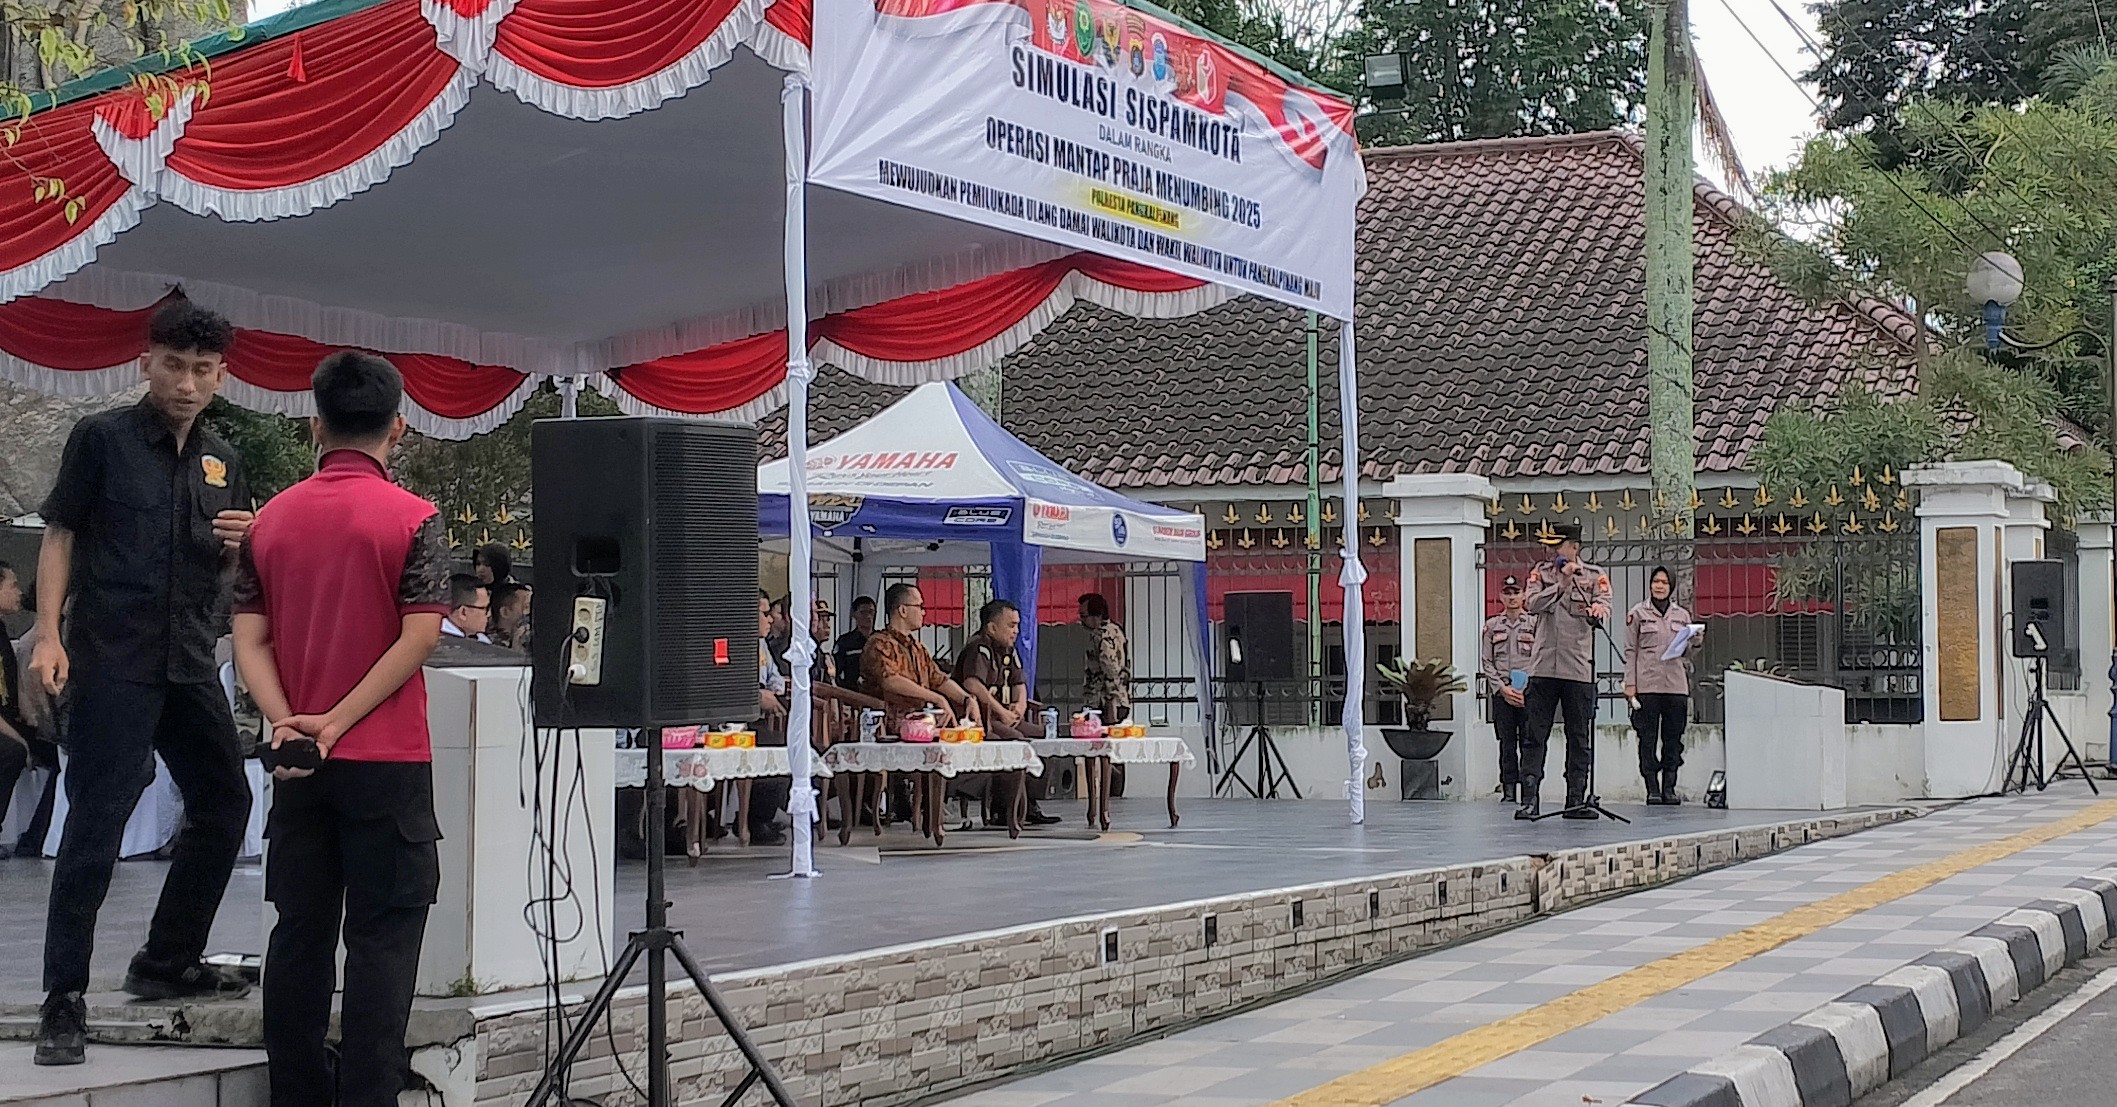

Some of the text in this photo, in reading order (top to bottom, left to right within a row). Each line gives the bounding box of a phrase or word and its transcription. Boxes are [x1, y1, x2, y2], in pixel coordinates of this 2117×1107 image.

[1012, 46, 1242, 163] SIMULASI SISPAMKOTA
[1099, 124, 1173, 164] DALAM RANGKA
[986, 117, 1261, 229] OPERASI MANTAP PRAJA MENUMBING 2025
[1091, 189, 1126, 213] POLRESTA
[878, 159, 958, 200] MEWUJUDKAN
[960, 182, 1025, 219] PEMILUKADA
[1026, 199, 1058, 227] ULANG
[1059, 207, 1091, 236] DAMAI
[1091, 217, 1136, 249] WALIKOTA
[1137, 230, 1155, 254] DAN
[1156, 235, 1182, 261] WAKIL
[1183, 242, 1222, 272] WALIKOTA
[1223, 251, 1249, 279] UNTUK
[837, 452, 959, 470] YAMAHA
[810, 510, 845, 523] YAMAHA
[957, 507, 1002, 516] BLUE
